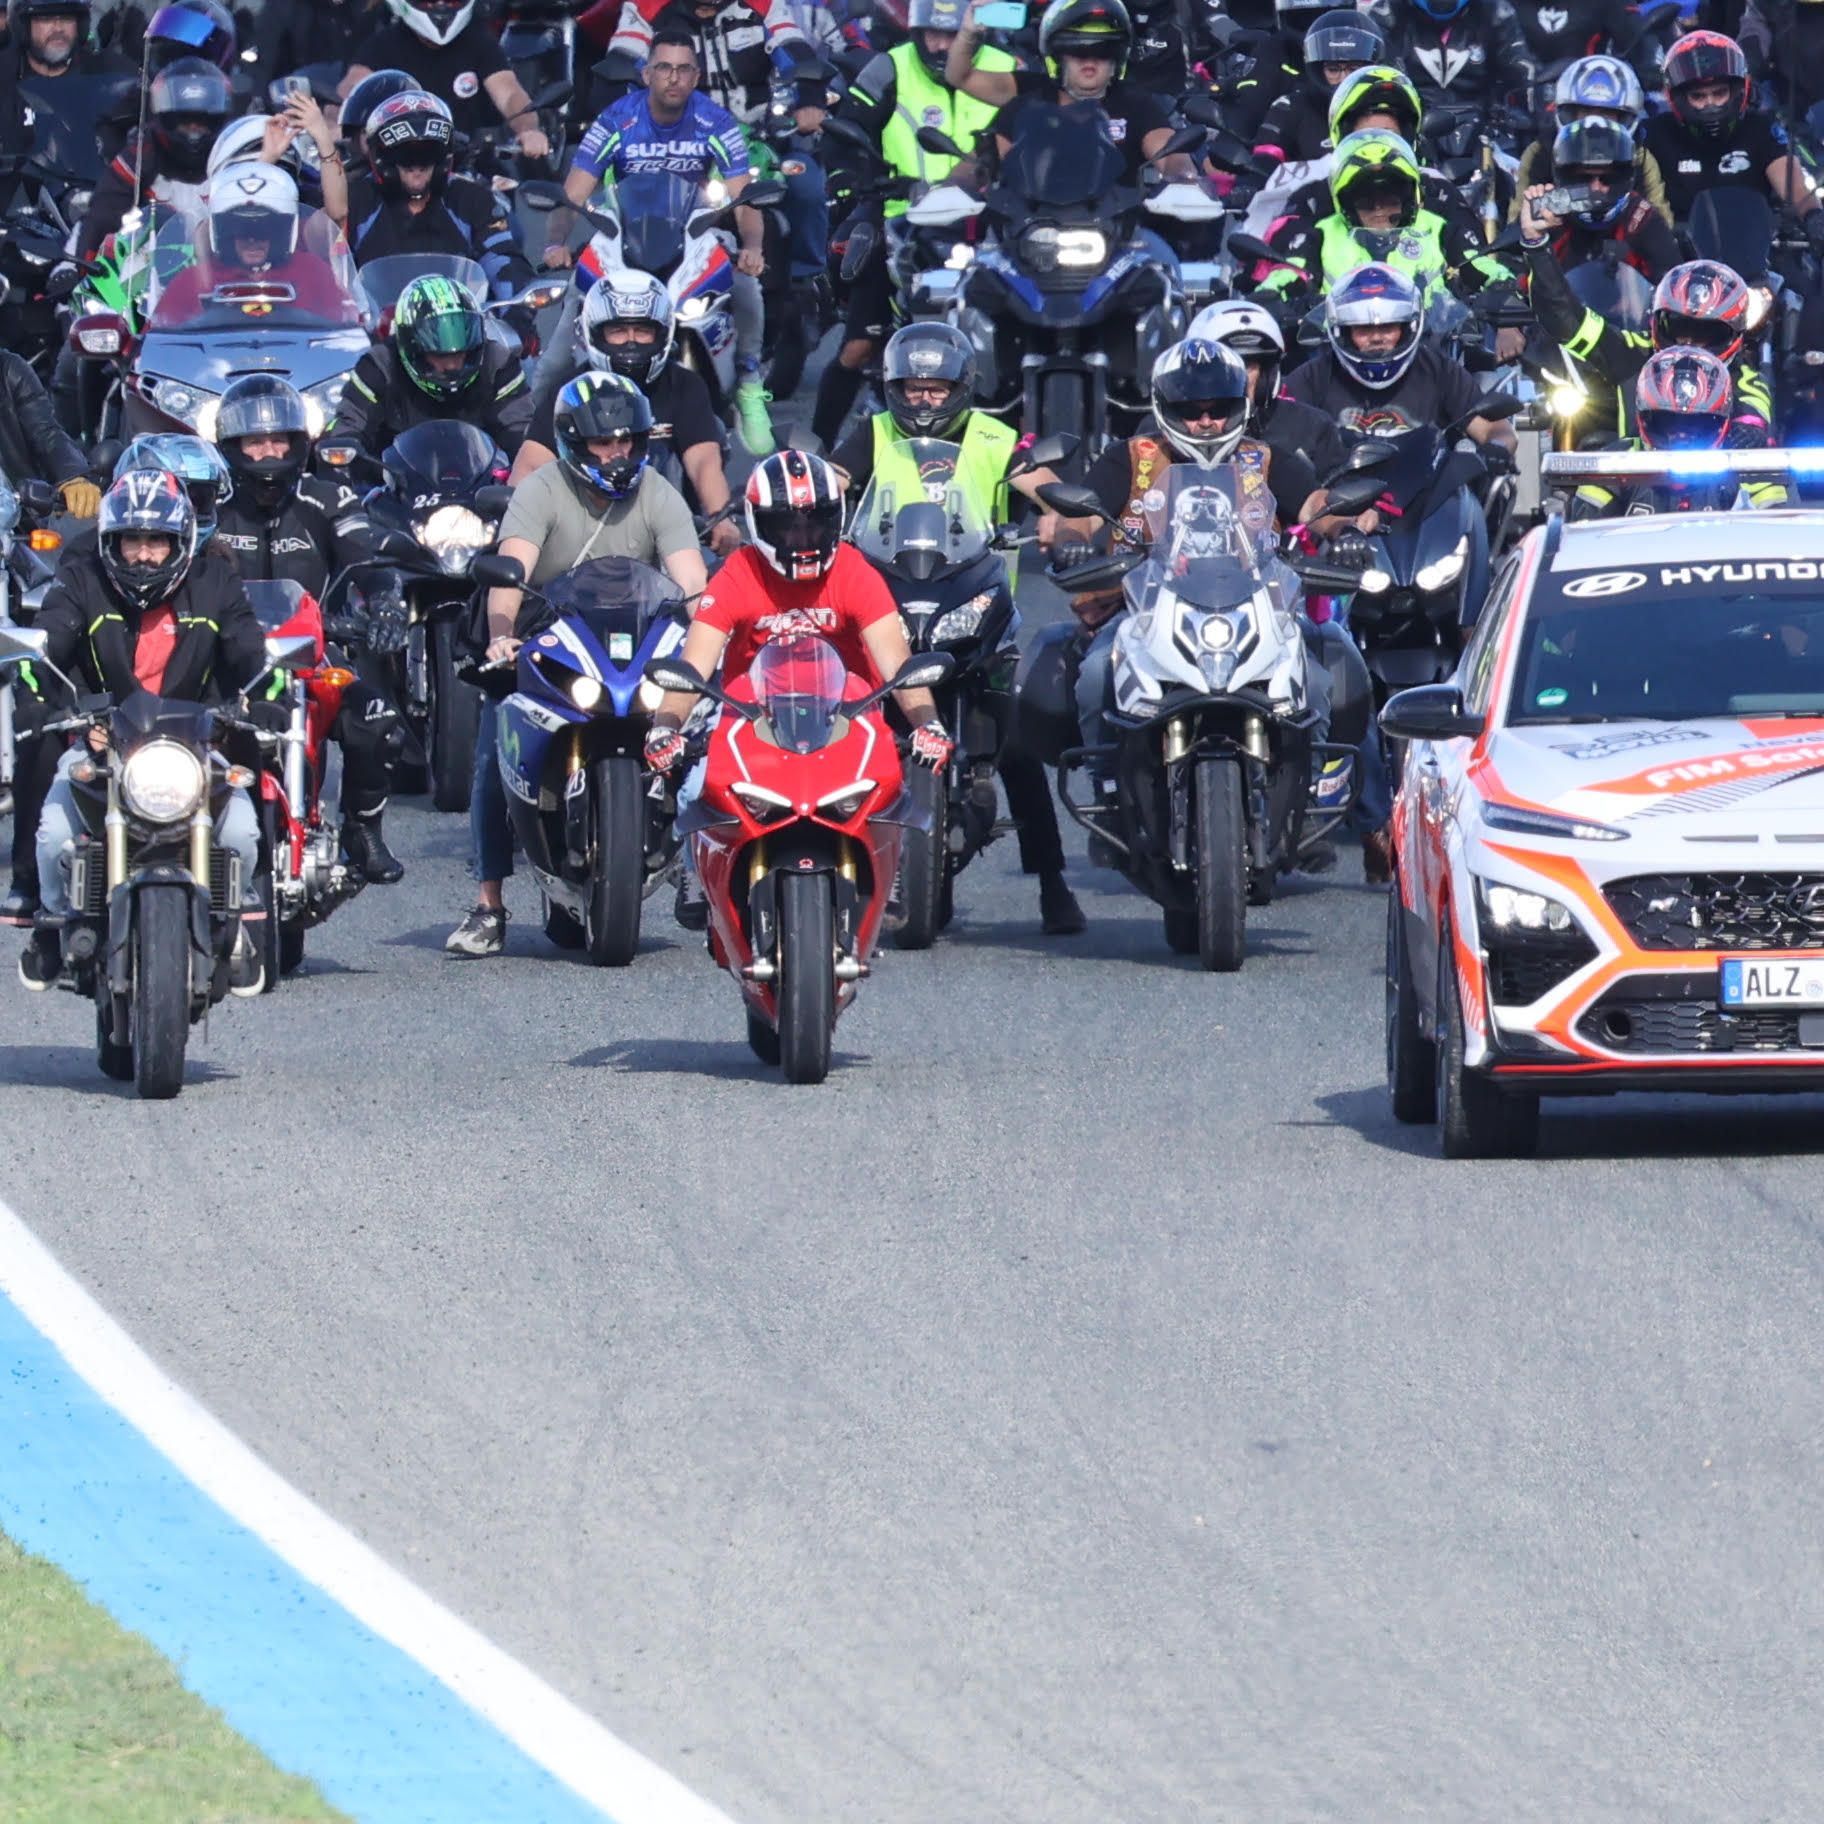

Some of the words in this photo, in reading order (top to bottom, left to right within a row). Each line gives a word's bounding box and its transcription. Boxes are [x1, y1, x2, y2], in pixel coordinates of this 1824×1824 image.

[627, 140, 707, 158] SUZUKI
[413, 493, 442, 509] 25
[1646, 756, 1739, 789] FIM
[1745, 966, 1802, 998] ALZ
